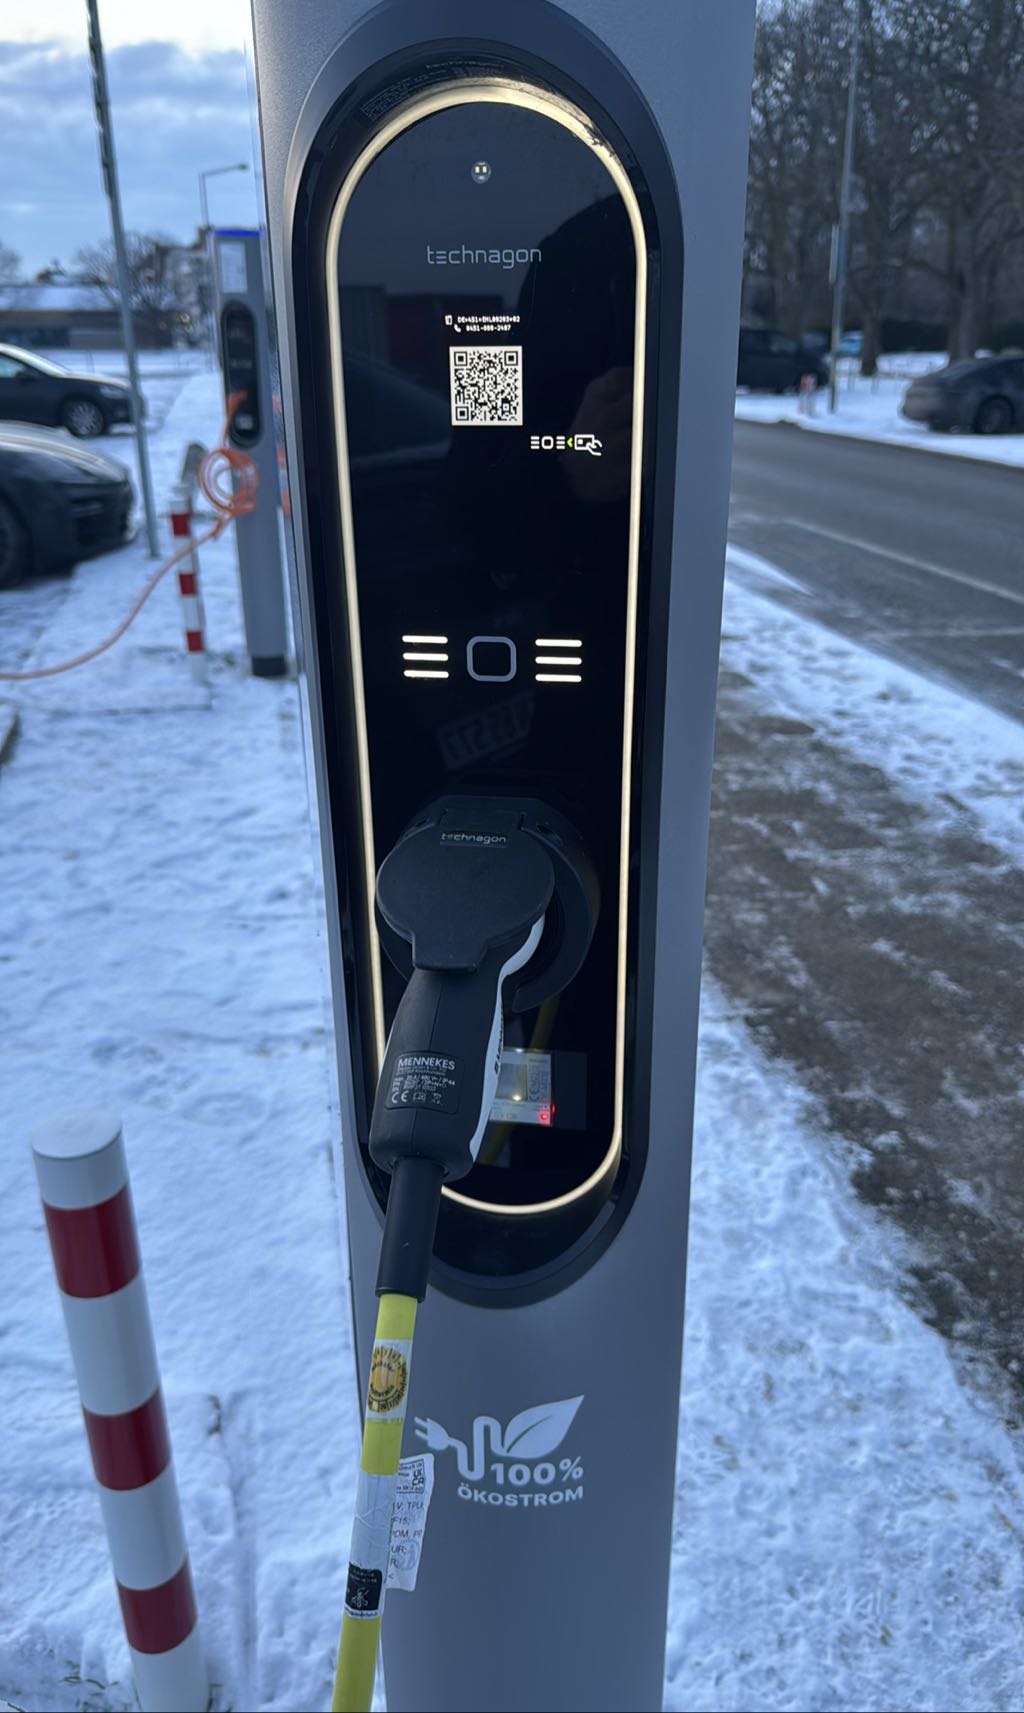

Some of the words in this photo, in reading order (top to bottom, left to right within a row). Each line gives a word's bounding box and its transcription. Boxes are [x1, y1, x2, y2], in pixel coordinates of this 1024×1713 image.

[426, 245, 542, 269] technagon
[441, 833, 506, 844] technagon
[397, 1056, 456, 1071] MENNEKES
[490, 1455, 584, 1486] 100%
[457, 1482, 584, 1508] ÖKOSTROM
